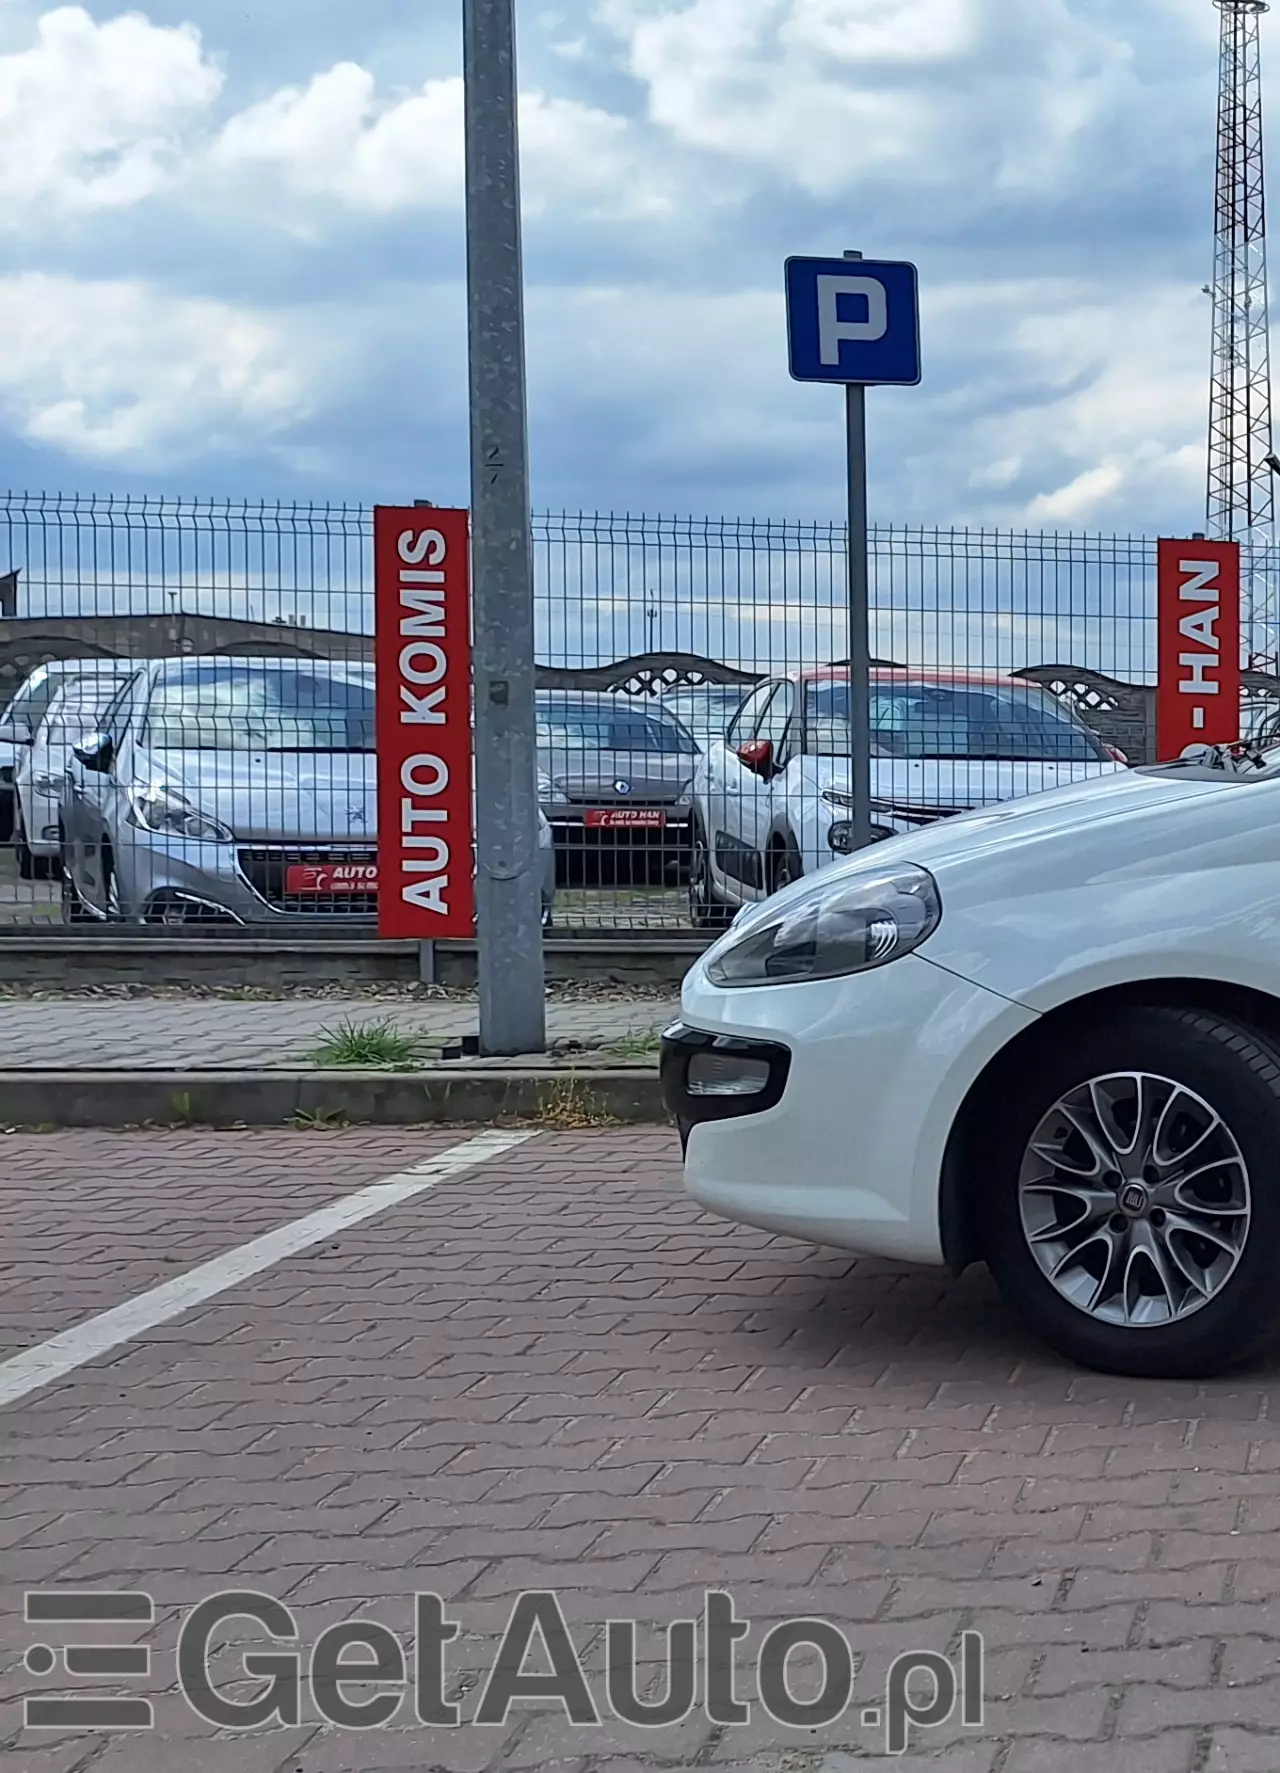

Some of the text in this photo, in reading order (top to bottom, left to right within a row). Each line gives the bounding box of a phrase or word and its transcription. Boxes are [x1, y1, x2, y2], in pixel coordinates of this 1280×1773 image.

[817, 275, 887, 365] P
[397, 528, 449, 915] AUTO KOMIS
[333, 866, 377, 879] AUTO
